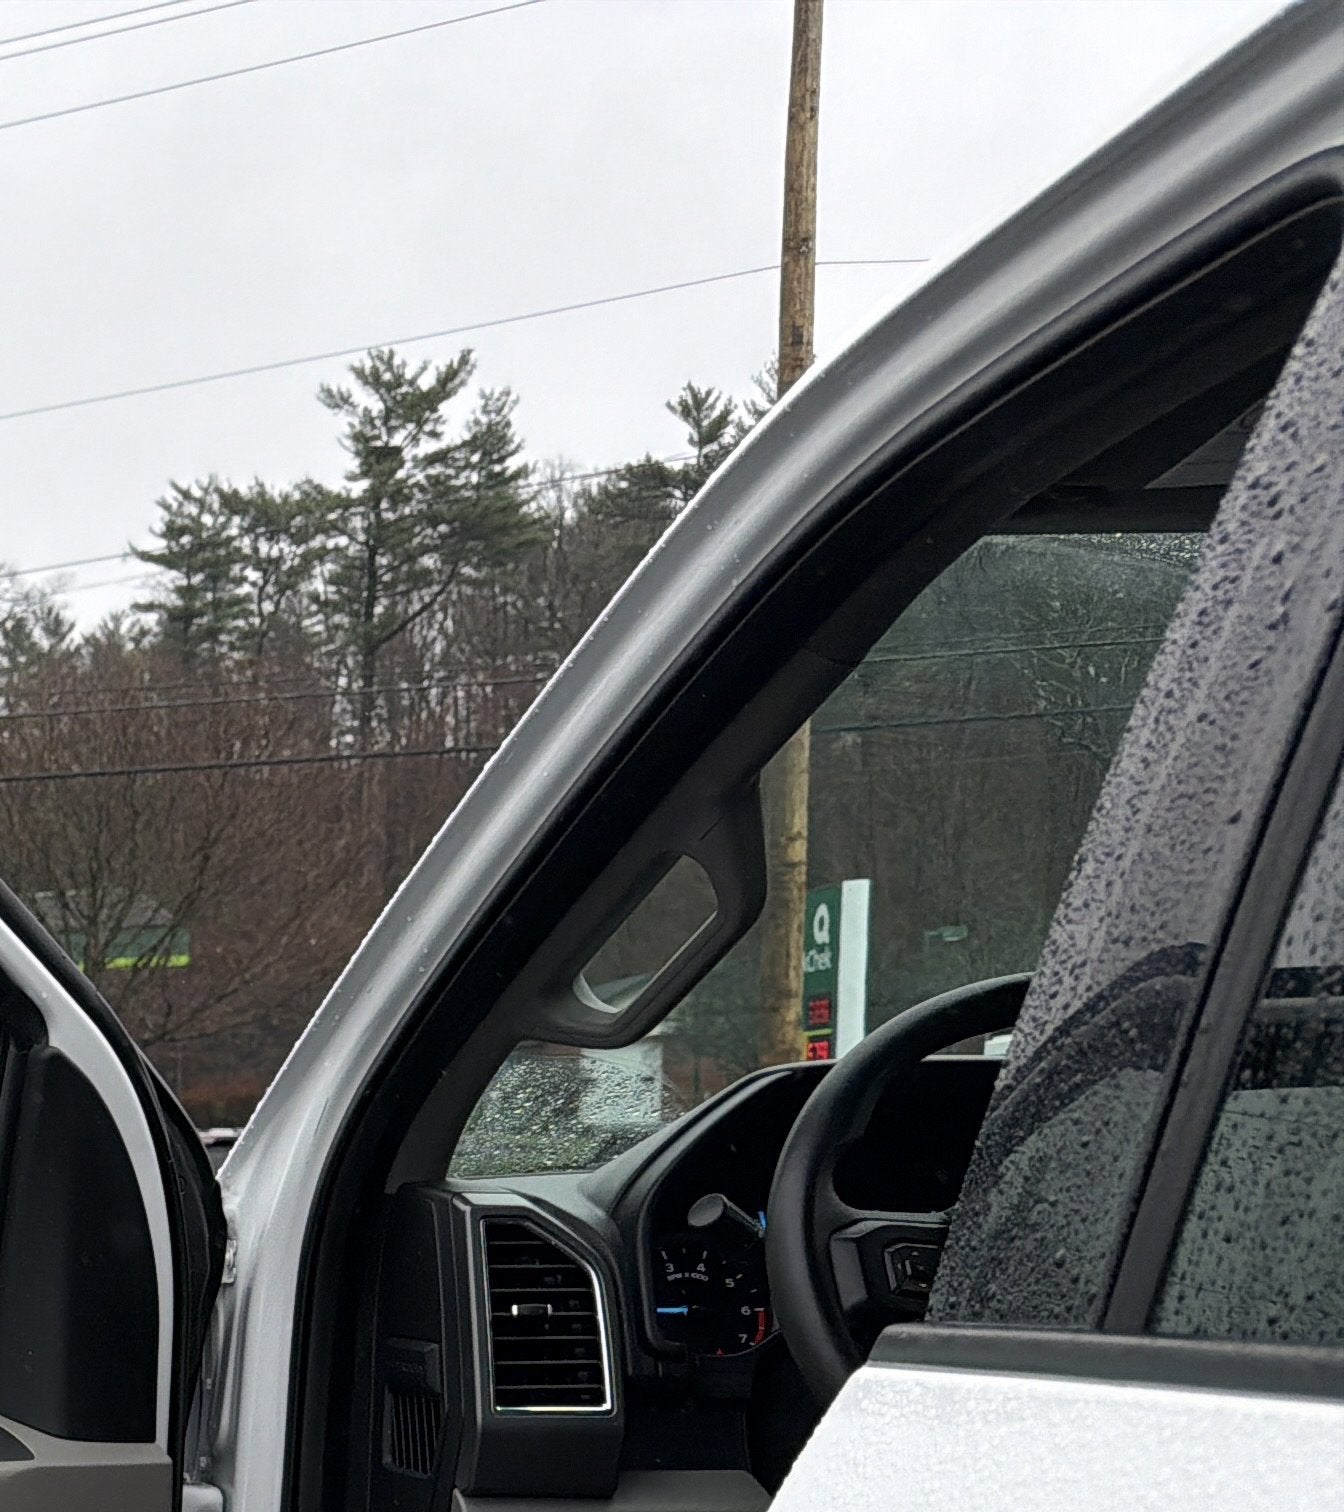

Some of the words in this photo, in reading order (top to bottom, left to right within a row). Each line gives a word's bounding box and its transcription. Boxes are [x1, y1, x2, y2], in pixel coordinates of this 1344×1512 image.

[813, 903, 830, 945] Q
[665, 1262, 675, 1273] 3
[696, 1262, 706, 1273] 4
[725, 1278, 735, 1288] 5
[740, 1306, 751, 1315] 6
[738, 1333, 748, 1344] 7
